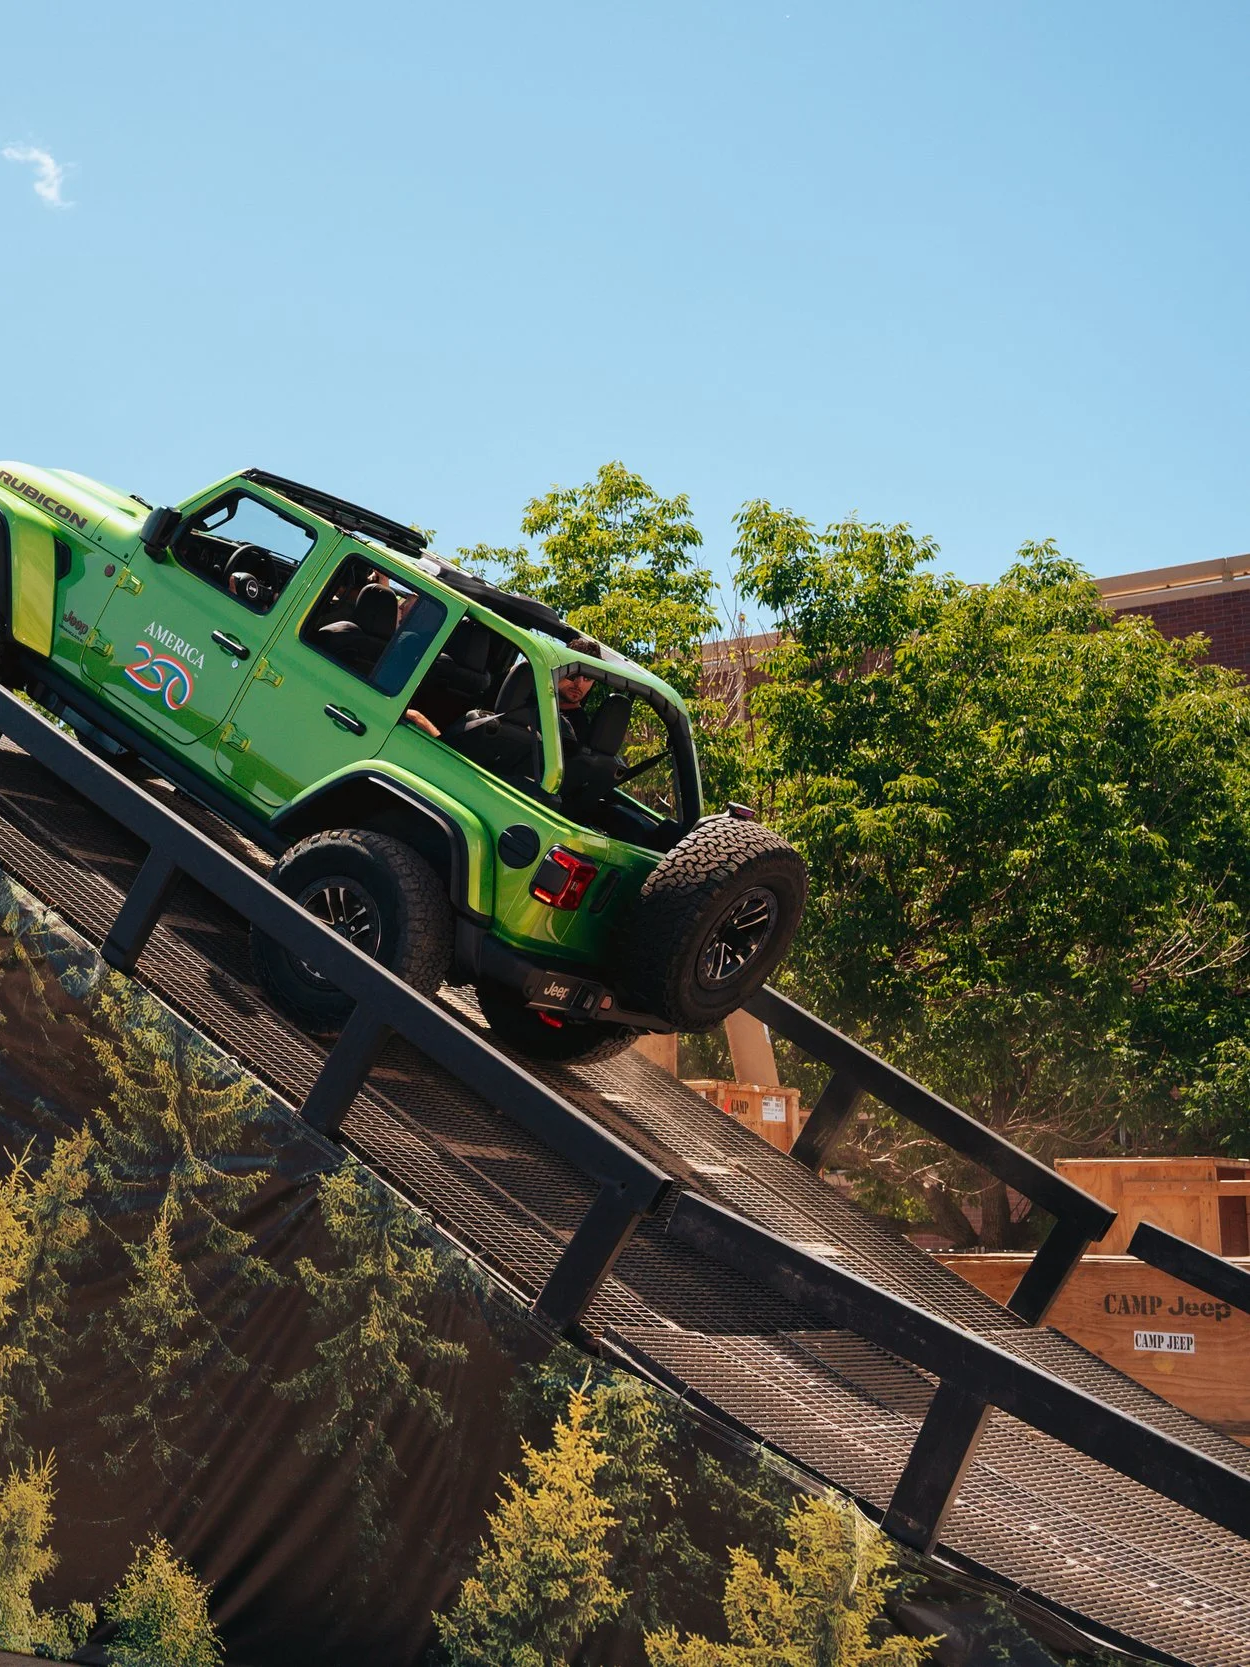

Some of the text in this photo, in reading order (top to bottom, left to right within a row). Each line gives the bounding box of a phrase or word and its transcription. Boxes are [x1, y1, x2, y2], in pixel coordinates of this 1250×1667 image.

[62, 610, 89, 635] Jeep
[143, 621, 205, 670] AMERICA
[543, 981, 570, 1001] Jeep
[1103, 1293, 1232, 1322] CAMP Jeep
[1135, 1333, 1194, 1351] CAMP JEEP
